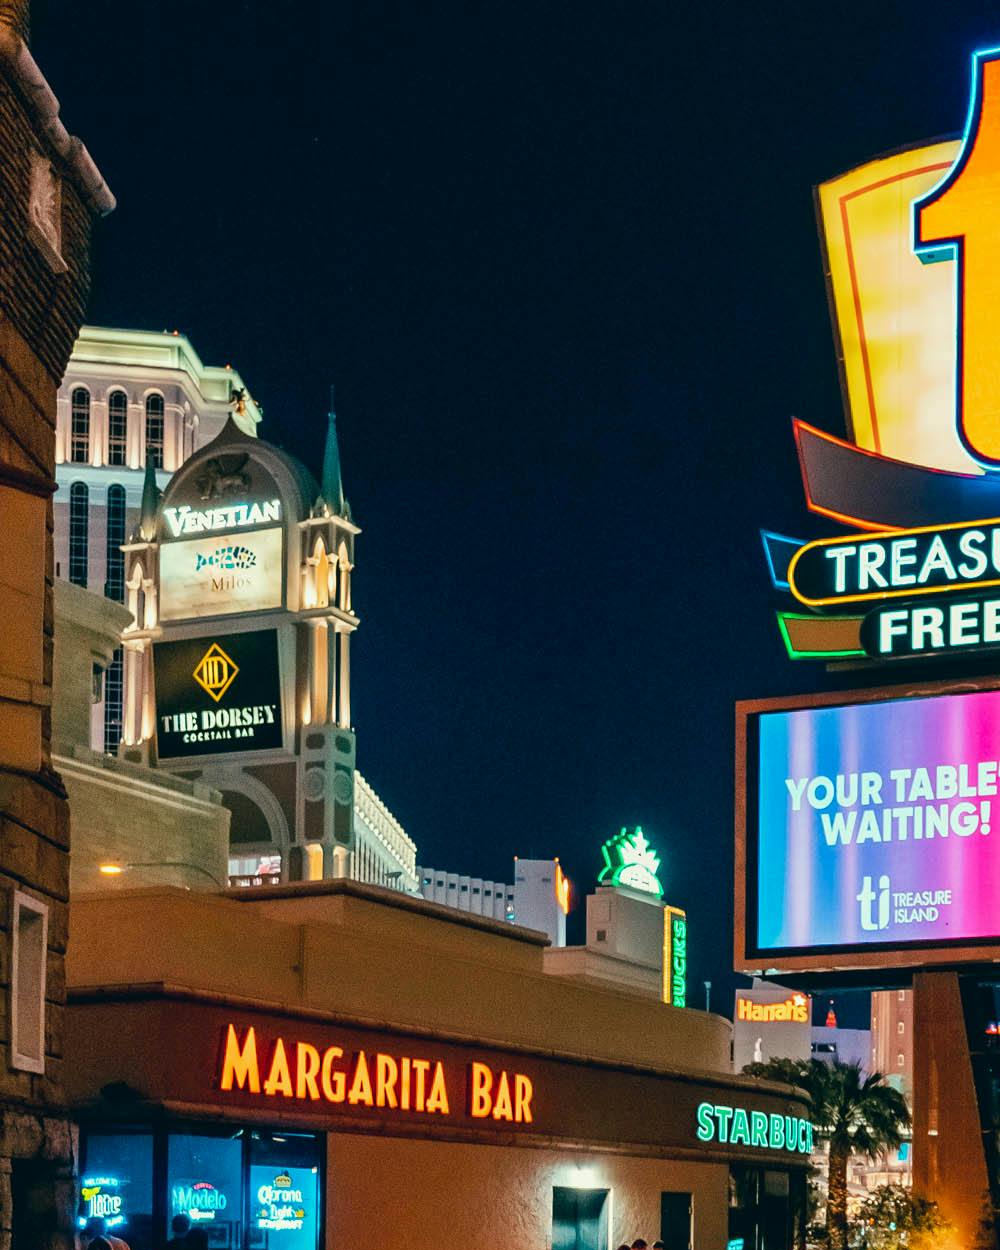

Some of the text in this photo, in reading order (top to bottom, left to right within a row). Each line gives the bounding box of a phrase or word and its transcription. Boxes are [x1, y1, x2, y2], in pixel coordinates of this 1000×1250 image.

[211, 575, 253, 593] Milos
[161, 705, 276, 733] THE DORSEY
[183, 726, 255, 744] COCKTAIL BAR
[785, 774, 882, 812] YOUR
[821, 801, 991, 846] WAITING!
[855, 874, 891, 931] ti
[892, 889, 953, 908] TREASURE
[894, 907, 939, 924] ISLAND
[219, 1023, 533, 1123] MARGARITA BAR
[177, 1187, 227, 1210] Modelo
[258, 1186, 303, 1205] Corona
